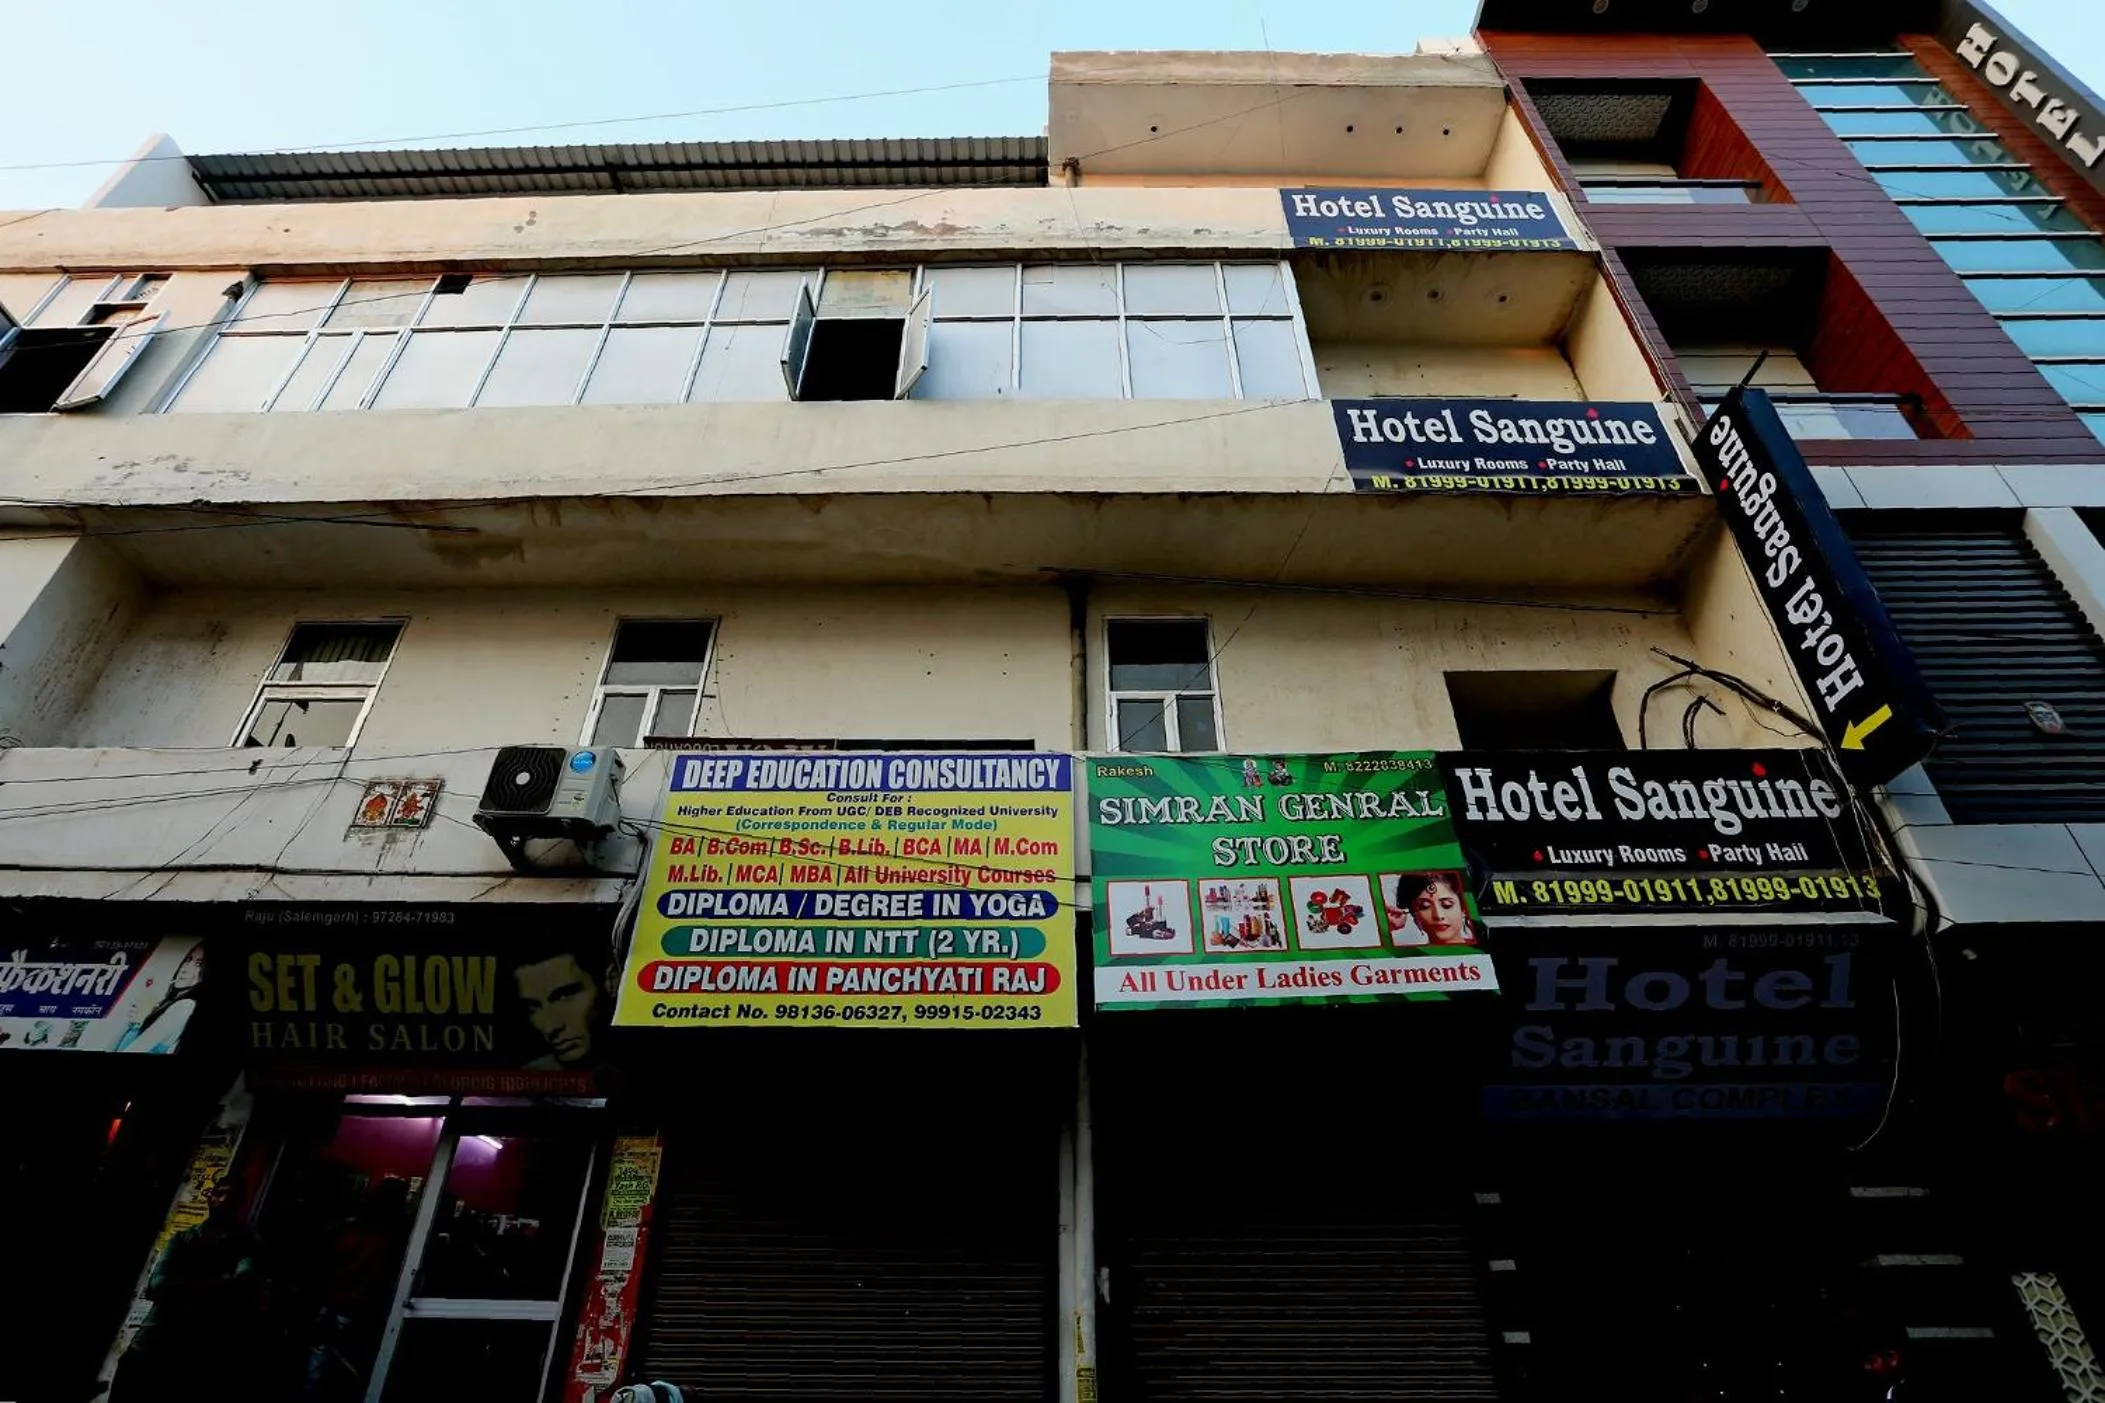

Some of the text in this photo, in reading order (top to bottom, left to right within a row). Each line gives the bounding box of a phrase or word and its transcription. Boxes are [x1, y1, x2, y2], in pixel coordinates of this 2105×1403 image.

[1956, 22, 2105, 167] HOTEL
[1292, 193, 1545, 226] Hotel Sanguine
[1308, 236, 1329, 246] M.
[1348, 225, 1519, 238] Luxury Rooms Party Hall
[1346, 407, 1657, 454] Hotel Sanguine
[1418, 457, 1626, 473] Luxury Rooms Party Hall
[1372, 475, 1399, 489] M.
[1710, 415, 1865, 712] Hotel Sanguine
[682, 759, 1059, 790] DEEP EDUCATION CONSULTANCY
[1097, 764, 1154, 778] Rakesh
[1324, 761, 1342, 772] M.
[677, 806, 722, 818] Higher
[726, 806, 794, 817] Education
[798, 806, 832, 817] From
[875, 806, 902, 817] DEB
[907, 806, 985, 818] Recognized
[989, 806, 1058, 818] University
[826, 793, 878, 804] Consult
[883, 793, 905, 804] For
[1099, 790, 1444, 827] SIMRAN GENRAL
[1455, 763, 1843, 835] Hotel Sanguine
[736, 819, 998, 832] (Correspondence & Regular Mode)
[670, 837, 696, 856] BA
[707, 837, 768, 856] B.Com
[903, 837, 942, 856] BCA
[953, 837, 982, 856] MA
[994, 837, 1058, 856] M.Com
[1212, 834, 1346, 867] STORE
[1548, 842, 1809, 868] Luxury Rooms Party Hall
[668, 864, 1057, 890] M.Lib. MCA MBA All University Courses
[1493, 875, 1881, 906] M. 81999-01911,81999-01913
[244, 910, 274, 925] Raju
[667, 892, 1046, 919] DIPLOMA / DEGREE IN YOGA
[690, 928, 1019, 957] DIPLOMA IN NTT (2 YR.)
[247, 951, 498, 1015] SET & GLOW
[653, 966, 1046, 993] DIPLOMA IN PANCHYATI RAJ
[1119, 961, 1482, 994] All Under Ladies Garments
[1524, 952, 1857, 1012] Hotel
[652, 1003, 1042, 1023] Contact No. 98136-06327, 99915-02343
[250, 1021, 496, 1053] HAIR SALON
[1510, 1023, 1863, 1081] Sanguine
[1511, 1088, 1660, 1111] BANSAL
